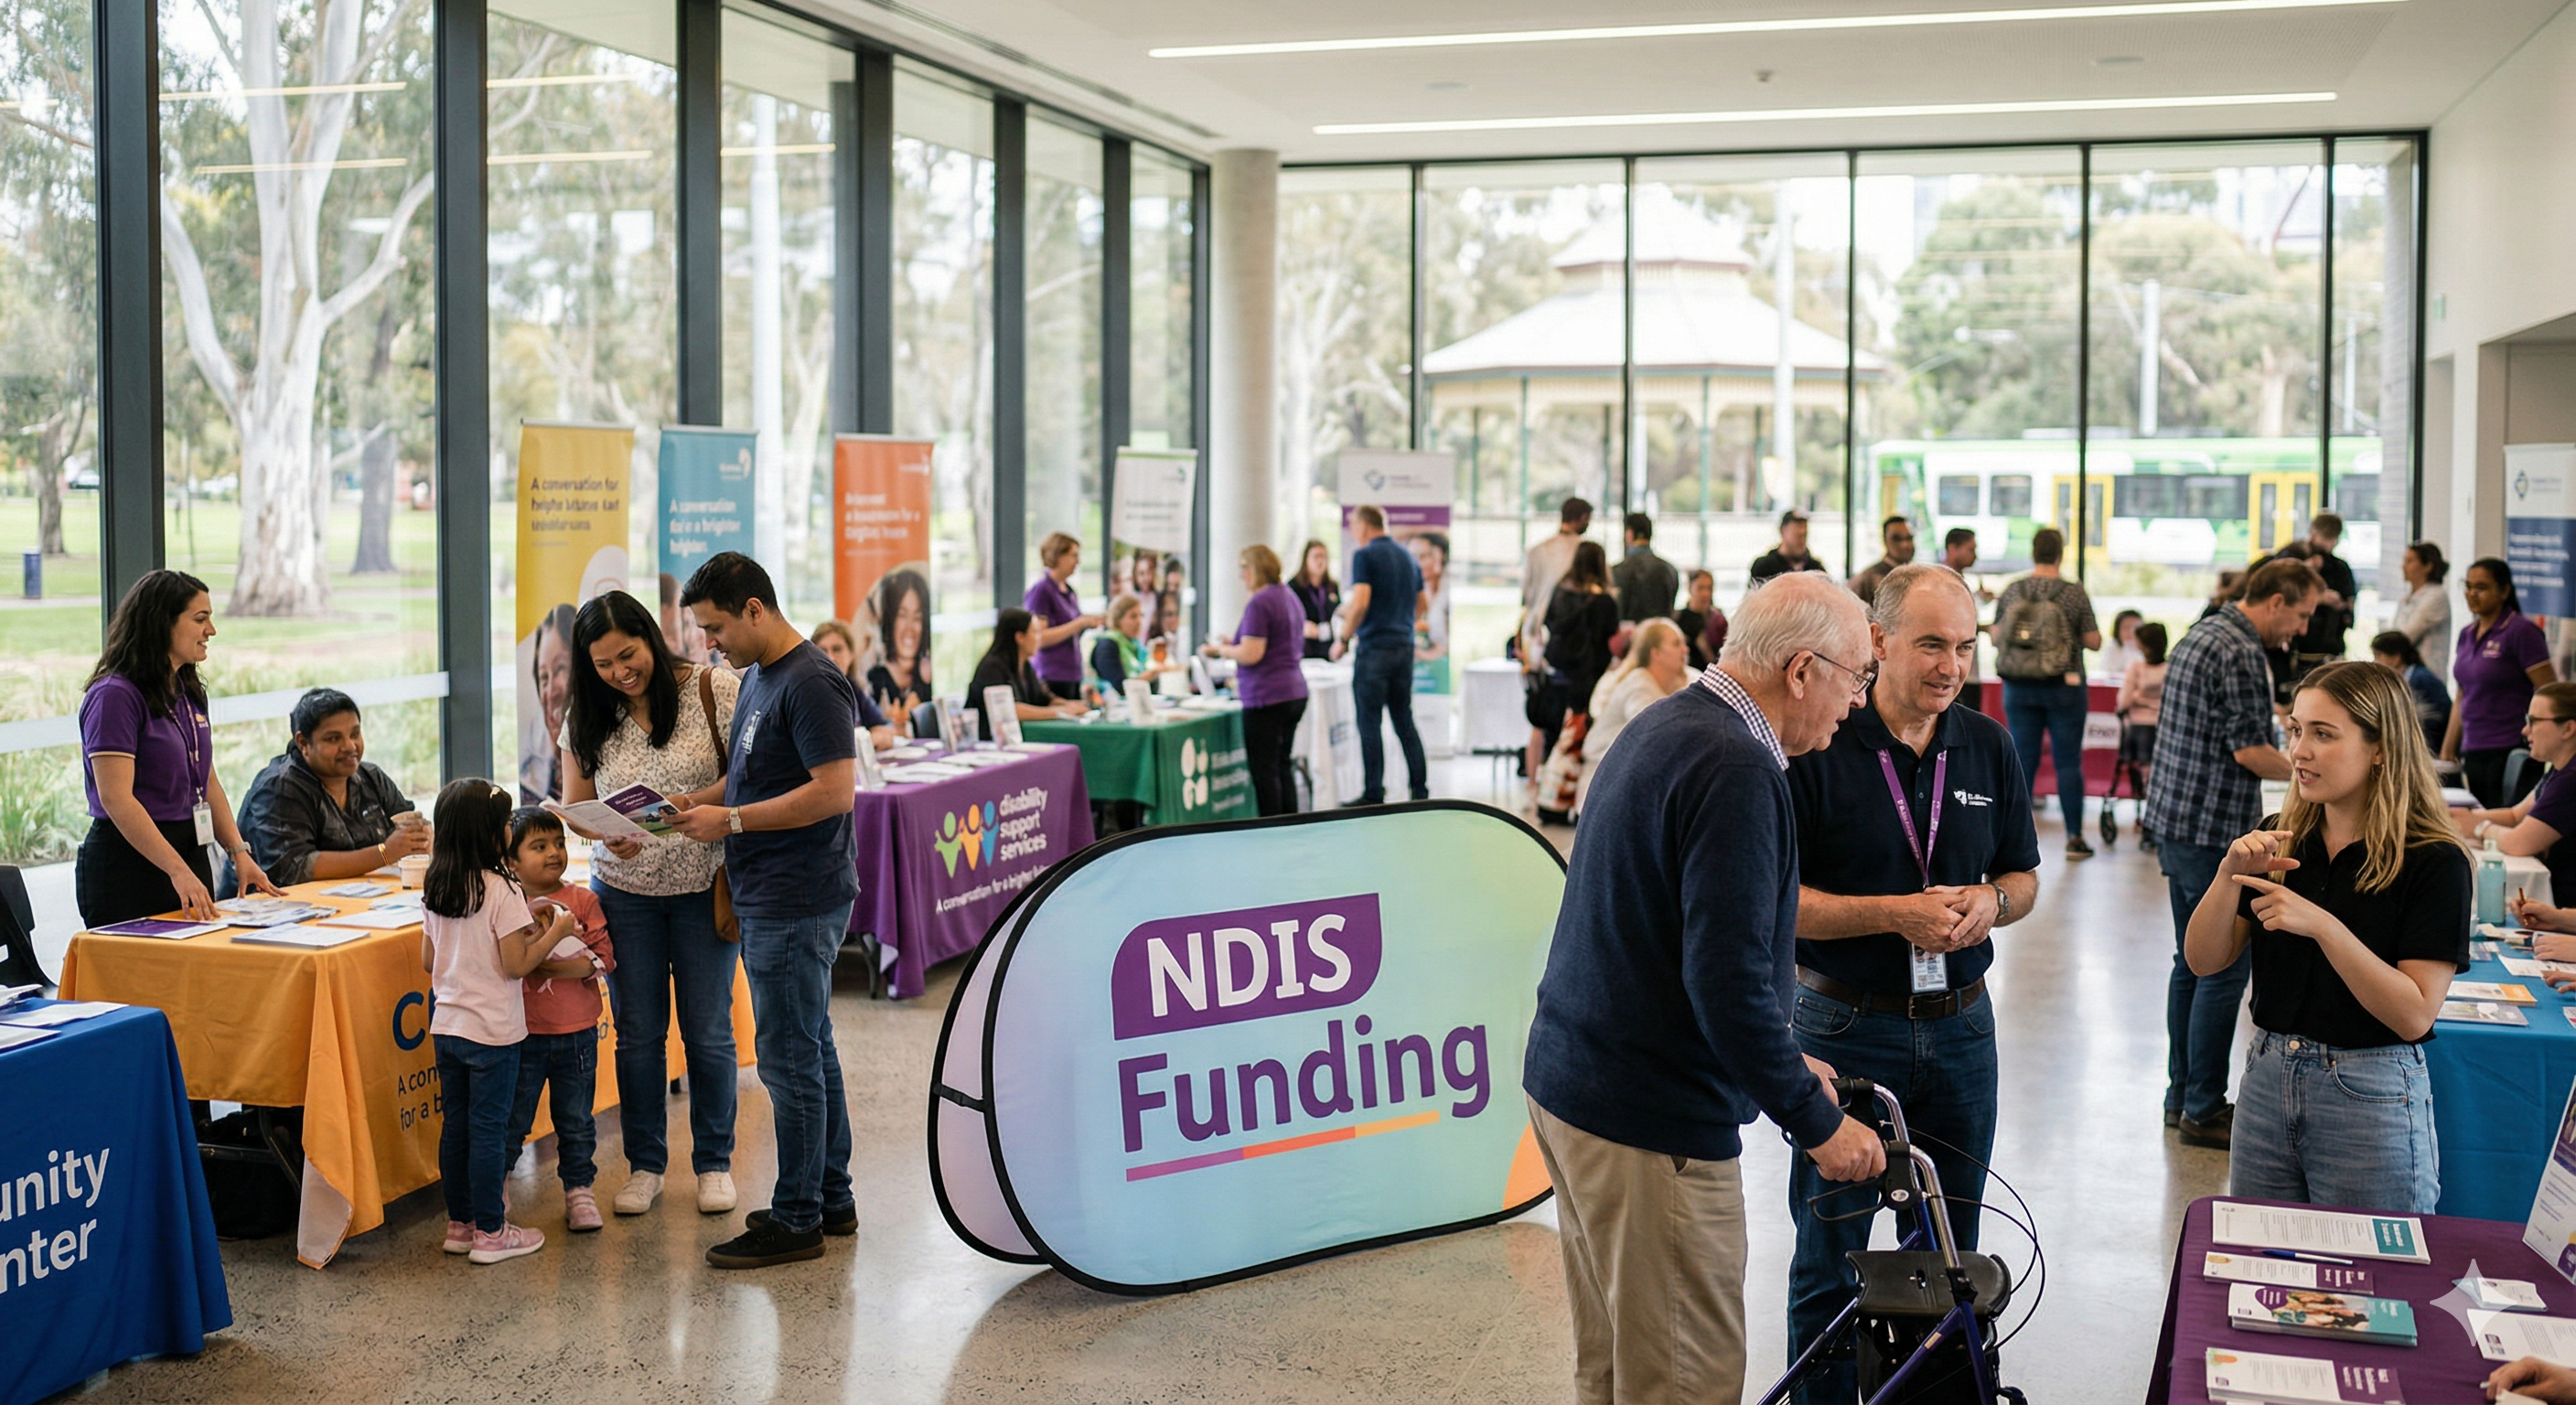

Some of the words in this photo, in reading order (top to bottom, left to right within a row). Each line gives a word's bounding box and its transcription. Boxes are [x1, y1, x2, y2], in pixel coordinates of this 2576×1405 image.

[531, 476, 540, 491] A
[999, 787, 1048, 817] disability
[1000, 810, 1040, 841] support
[1000, 833, 1047, 862] services
[936, 898, 943, 915] A
[943, 885, 992, 912] conversation
[1146, 913, 1353, 1018] NDIS
[398, 1074, 407, 1098] A
[409, 1065, 441, 1092] con
[1118, 1014, 1491, 1153] Funding
[401, 1106, 416, 1132] for
[420, 1101, 429, 1121] a
